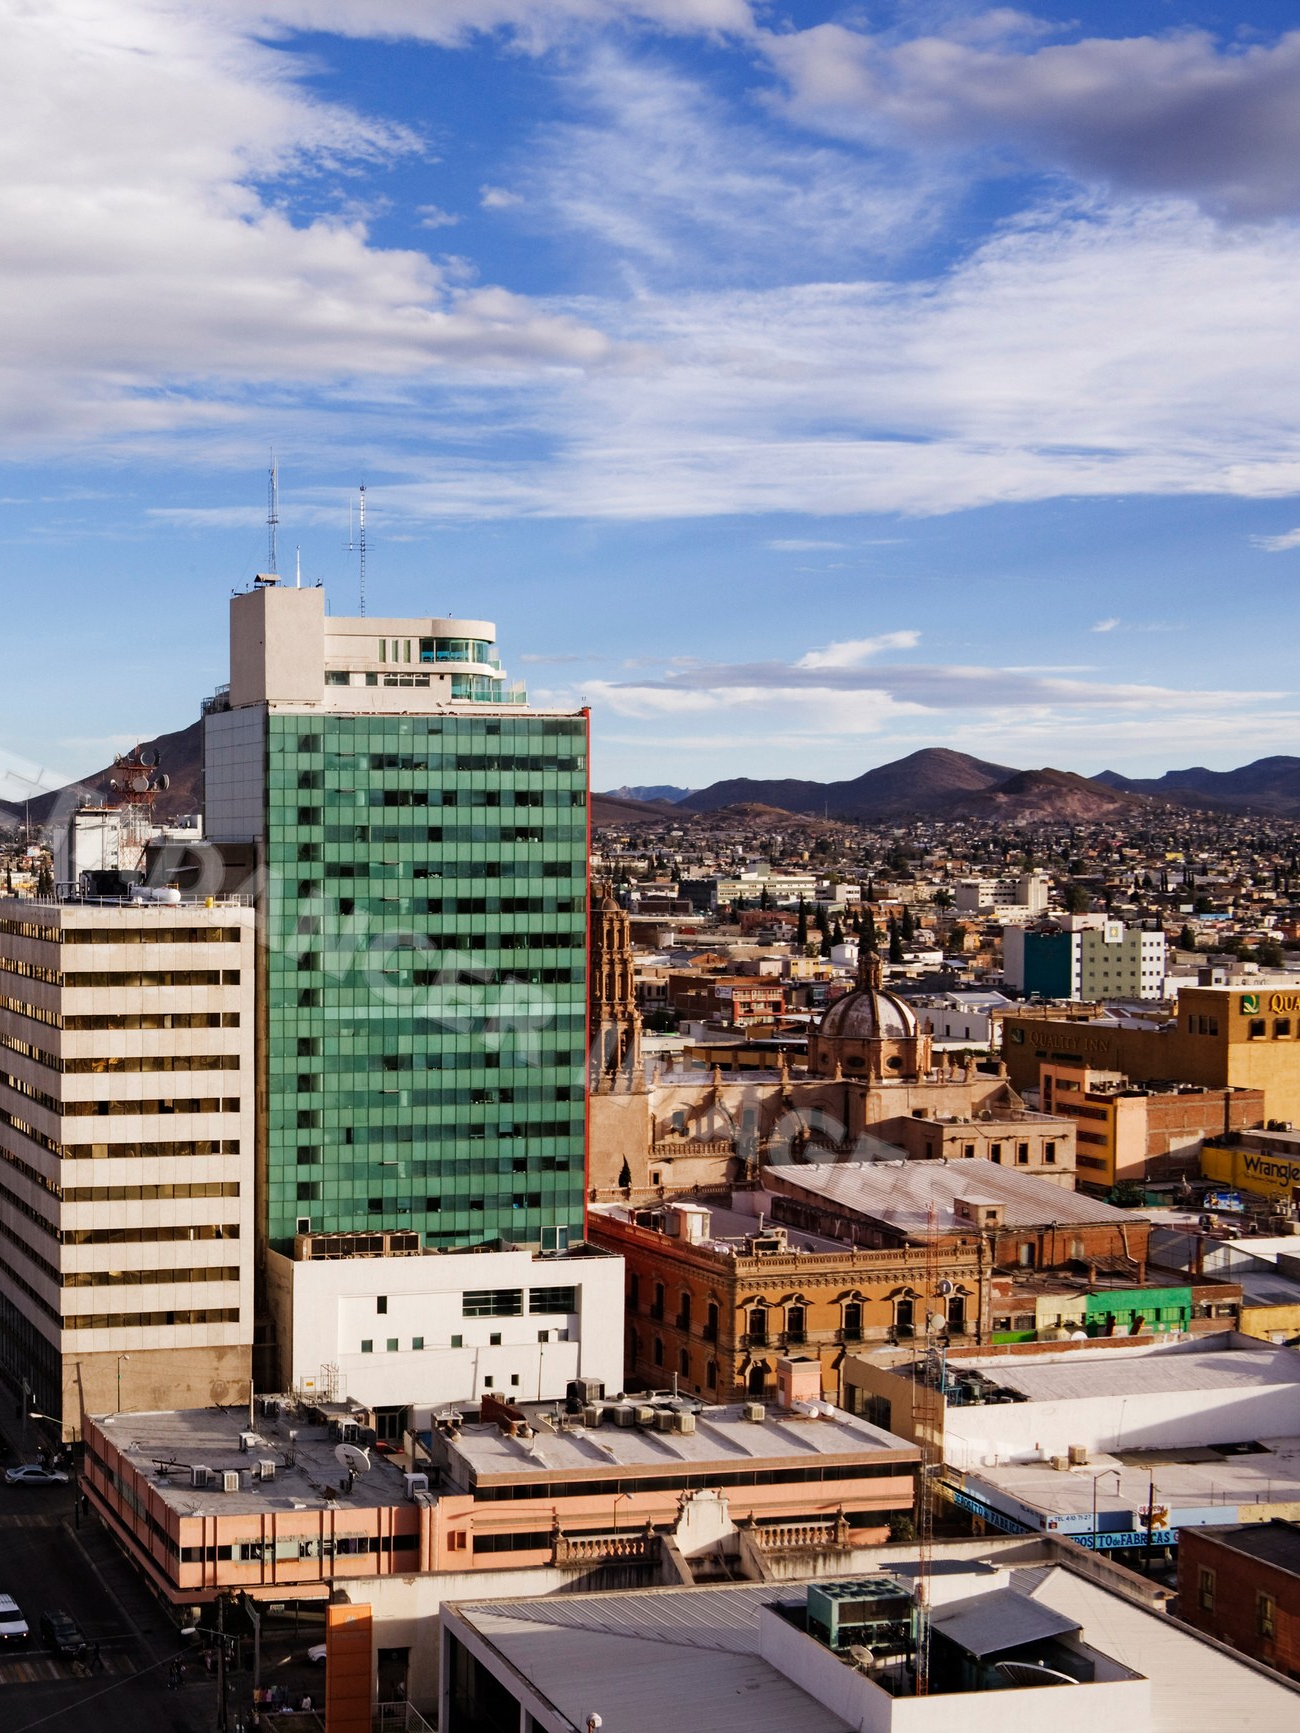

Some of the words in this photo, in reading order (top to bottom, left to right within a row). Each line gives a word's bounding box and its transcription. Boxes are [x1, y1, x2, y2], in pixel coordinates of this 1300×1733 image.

[1029, 1031, 1078, 1049] QUALITY
[1084, 1038, 1109, 1052] INN
[1243, 1154, 1300, 1187] Wrangle
[1112, 1538, 1120, 1546] de
[1120, 1531, 1170, 1546] FABRCAS
